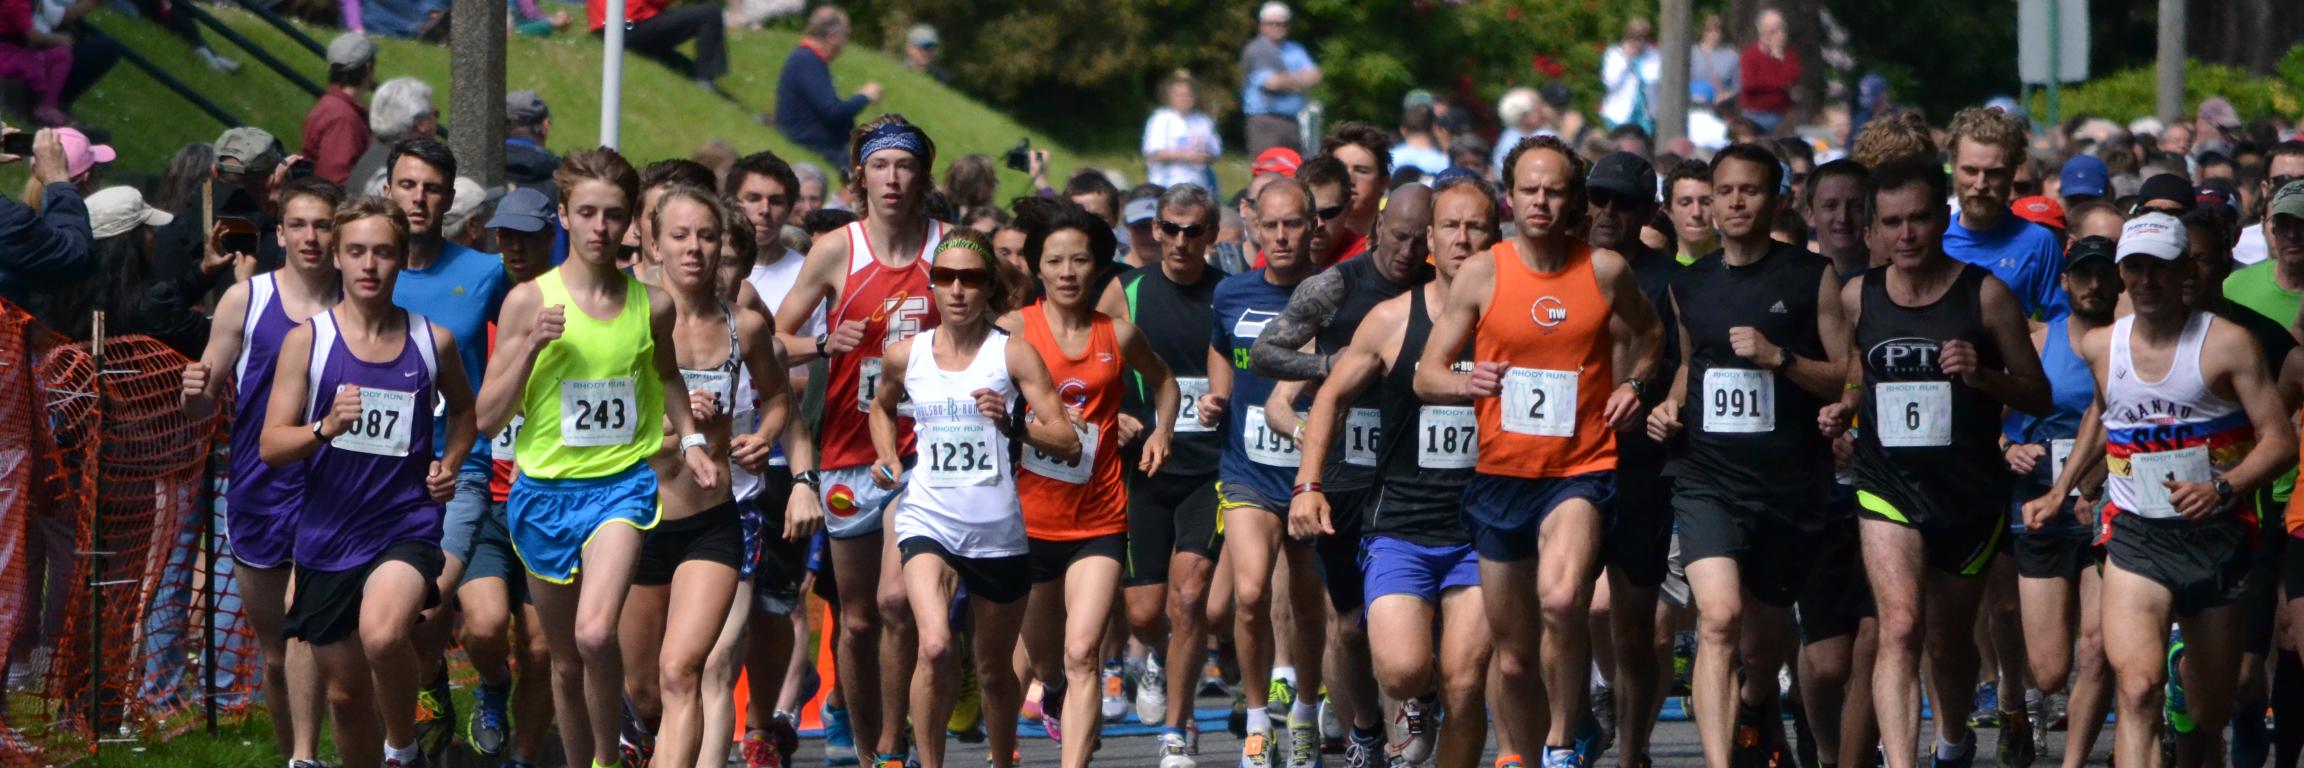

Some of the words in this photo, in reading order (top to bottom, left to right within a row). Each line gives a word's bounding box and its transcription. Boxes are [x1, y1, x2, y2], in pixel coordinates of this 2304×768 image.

[1882, 345, 1939, 367] PT
[573, 381, 604, 389] RHODY
[608, 380, 626, 388] RUN
[1512, 370, 1543, 378] RHODY
[1546, 372, 1567, 380] RUN
[575, 398, 626, 430] 243
[1529, 388, 1546, 419] 2
[1715, 388, 1760, 417] 991
[1905, 401, 1920, 431] 6
[2125, 399, 2192, 424] HANAU
[932, 425, 960, 433] RHODY
[963, 424, 984, 433] RUN
[1426, 424, 1475, 454] 187
[930, 441, 993, 472] 1232
[2140, 453, 2171, 462] RHODY
[2174, 450, 2196, 459] RUN
